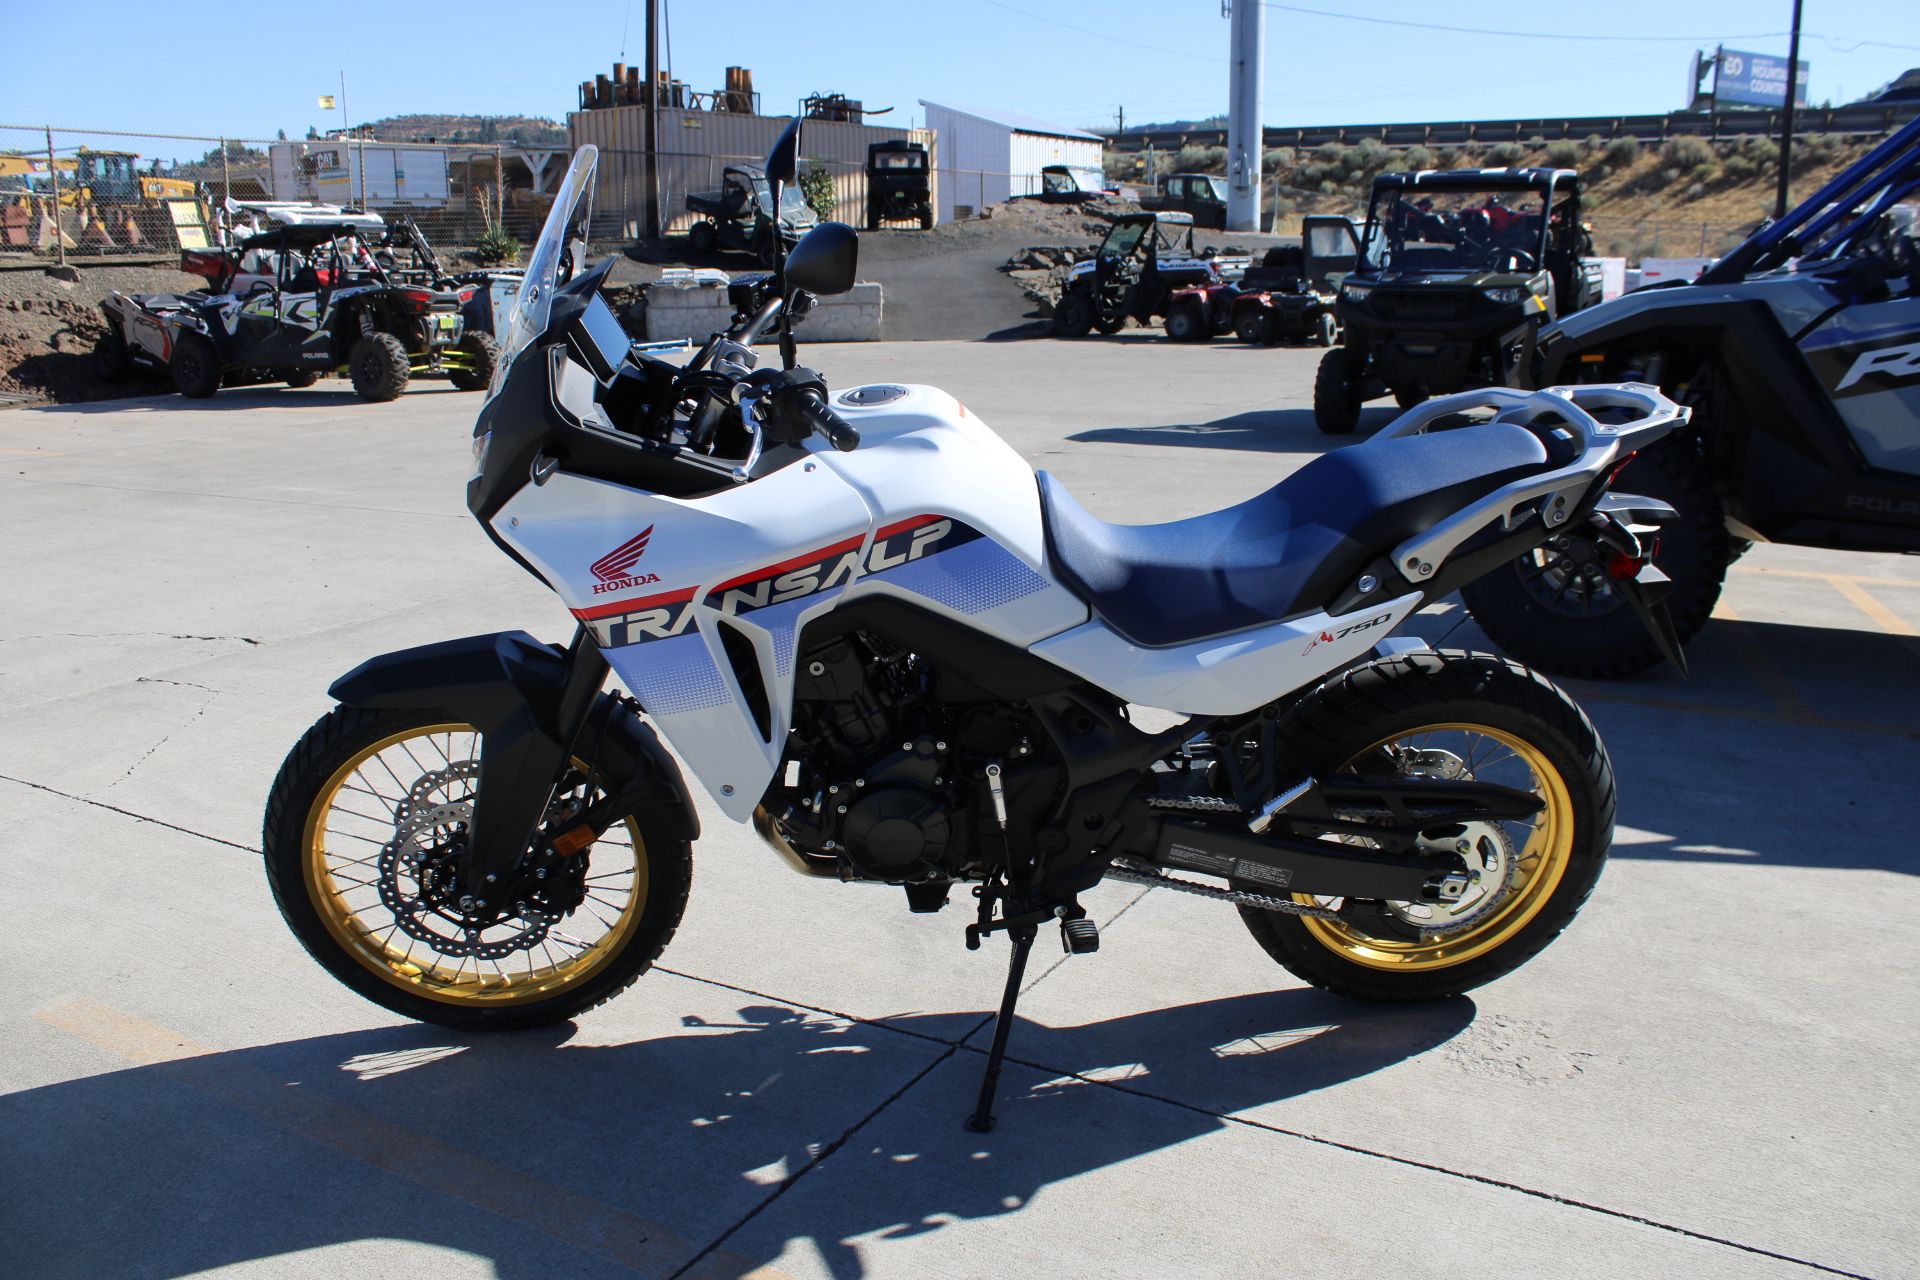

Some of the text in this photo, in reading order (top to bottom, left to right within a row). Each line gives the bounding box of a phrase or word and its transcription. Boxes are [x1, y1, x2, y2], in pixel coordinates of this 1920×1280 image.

[1751, 66, 1808, 84] MOUNTAER
[1750, 79, 1787, 96] COUNTR
[302, 352, 329, 360] POLARIS
[1845, 494, 1920, 516] POLA
[588, 518, 952, 648] TRANSALP
[591, 573, 661, 594] HONDA
[1336, 613, 1392, 640] 750
